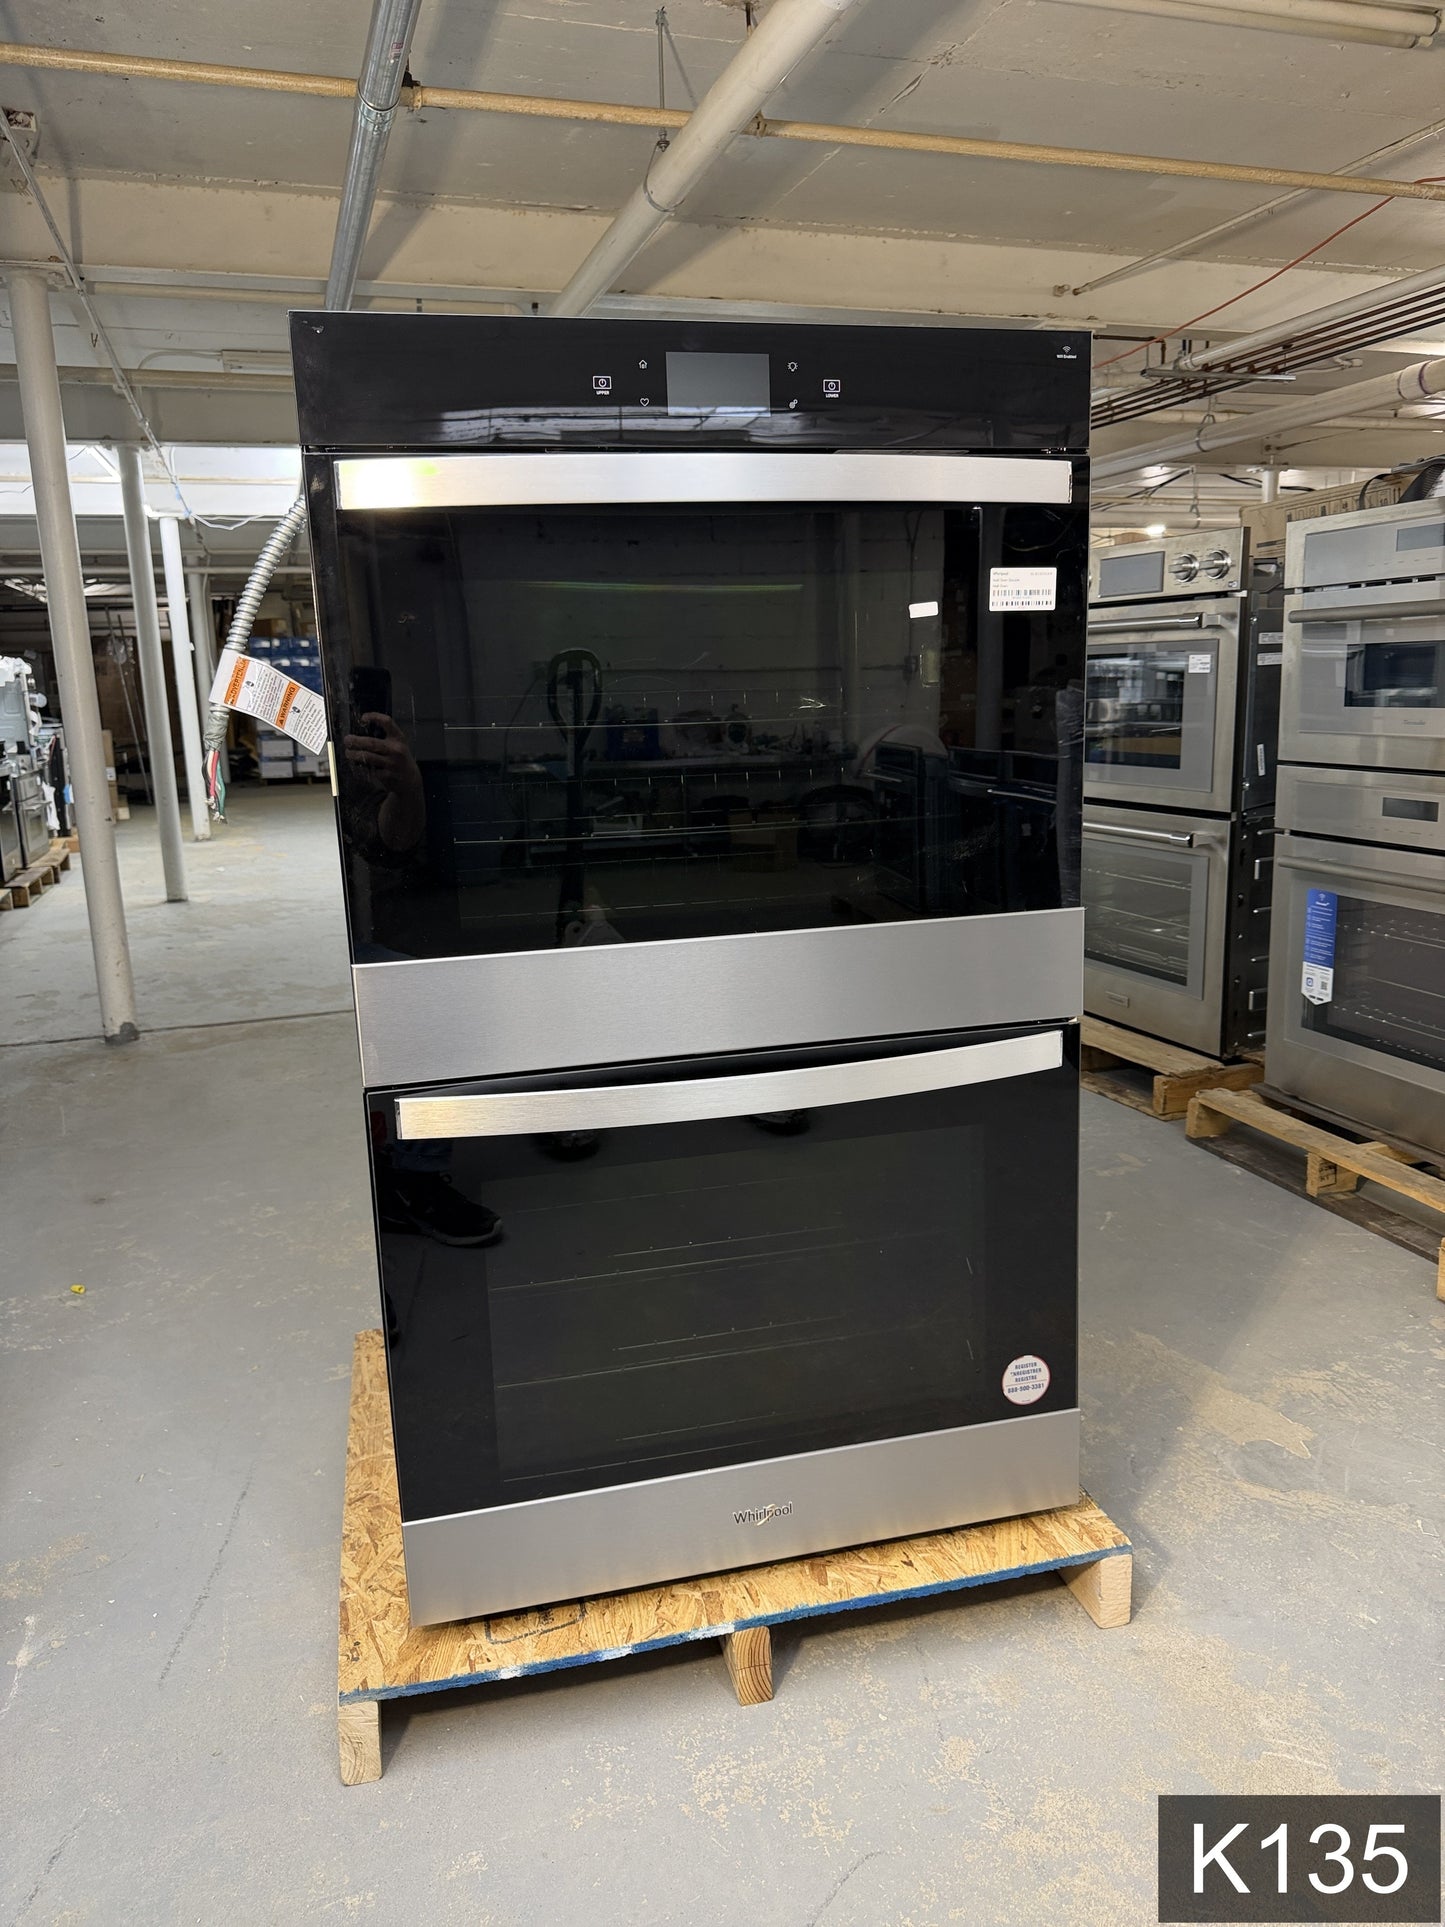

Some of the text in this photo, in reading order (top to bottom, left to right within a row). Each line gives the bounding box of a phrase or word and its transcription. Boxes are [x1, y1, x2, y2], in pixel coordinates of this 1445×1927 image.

[280, 687, 296, 718] WARNING
[1015, 1362, 1037, 1370] REGISTER
[733, 1502, 792, 1524] Whirlpool
